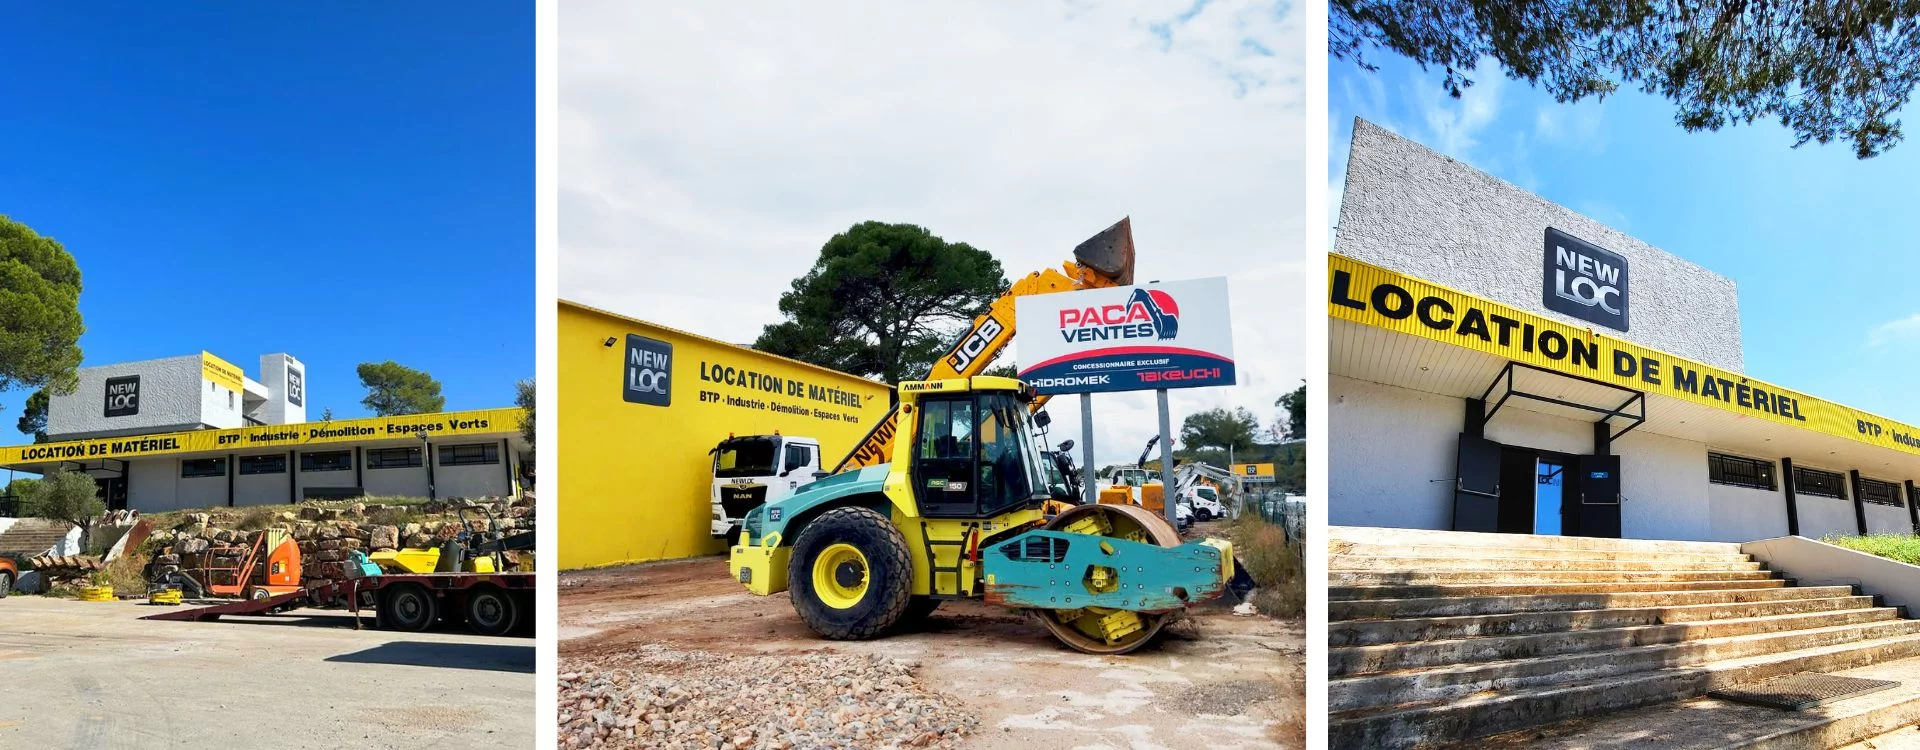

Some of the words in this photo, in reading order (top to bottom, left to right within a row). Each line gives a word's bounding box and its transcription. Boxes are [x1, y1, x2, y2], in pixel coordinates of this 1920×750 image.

[1556, 245, 1620, 286] NEW
[1555, 268, 1621, 316] LOC
[1059, 302, 1152, 329] PACA
[953, 317, 1002, 372] JCB
[1060, 322, 1154, 343] VENTES
[1331, 269, 1599, 370] LOCATION
[1613, 349, 1662, 386] DE
[1672, 365, 1807, 422] MATÉRIEL
[630, 347, 668, 370] NEW
[1072, 360, 1136, 370] CONCESSIONNAIRE
[1136, 358, 1170, 367] EXCLUSIF
[109, 382, 137, 395] NEW
[629, 367, 667, 395] LOC
[700, 361, 783, 395] LOCATION
[787, 379, 805, 398] DE
[808, 383, 863, 409] MATÉRIEL
[903, 382, 943, 392] AMMANN
[108, 394, 136, 411] LOC
[699, 390, 720, 404] BTP
[726, 395, 765, 410] Industrie
[771, 401, 810, 417] Démolition
[813, 408, 841, 421] Espaces
[842, 413, 859, 424] Verts
[218, 434, 240, 444] BTP
[250, 431, 300, 443] Industrie
[310, 427, 375, 439] Démolition
[386, 422, 444, 436] Espaces
[449, 417, 489, 430] Verts
[1856, 419, 1882, 437] BTP
[21, 445, 85, 460] LOCATION
[89, 443, 107, 455] DE
[111, 437, 181, 454] MATÉRIEL
